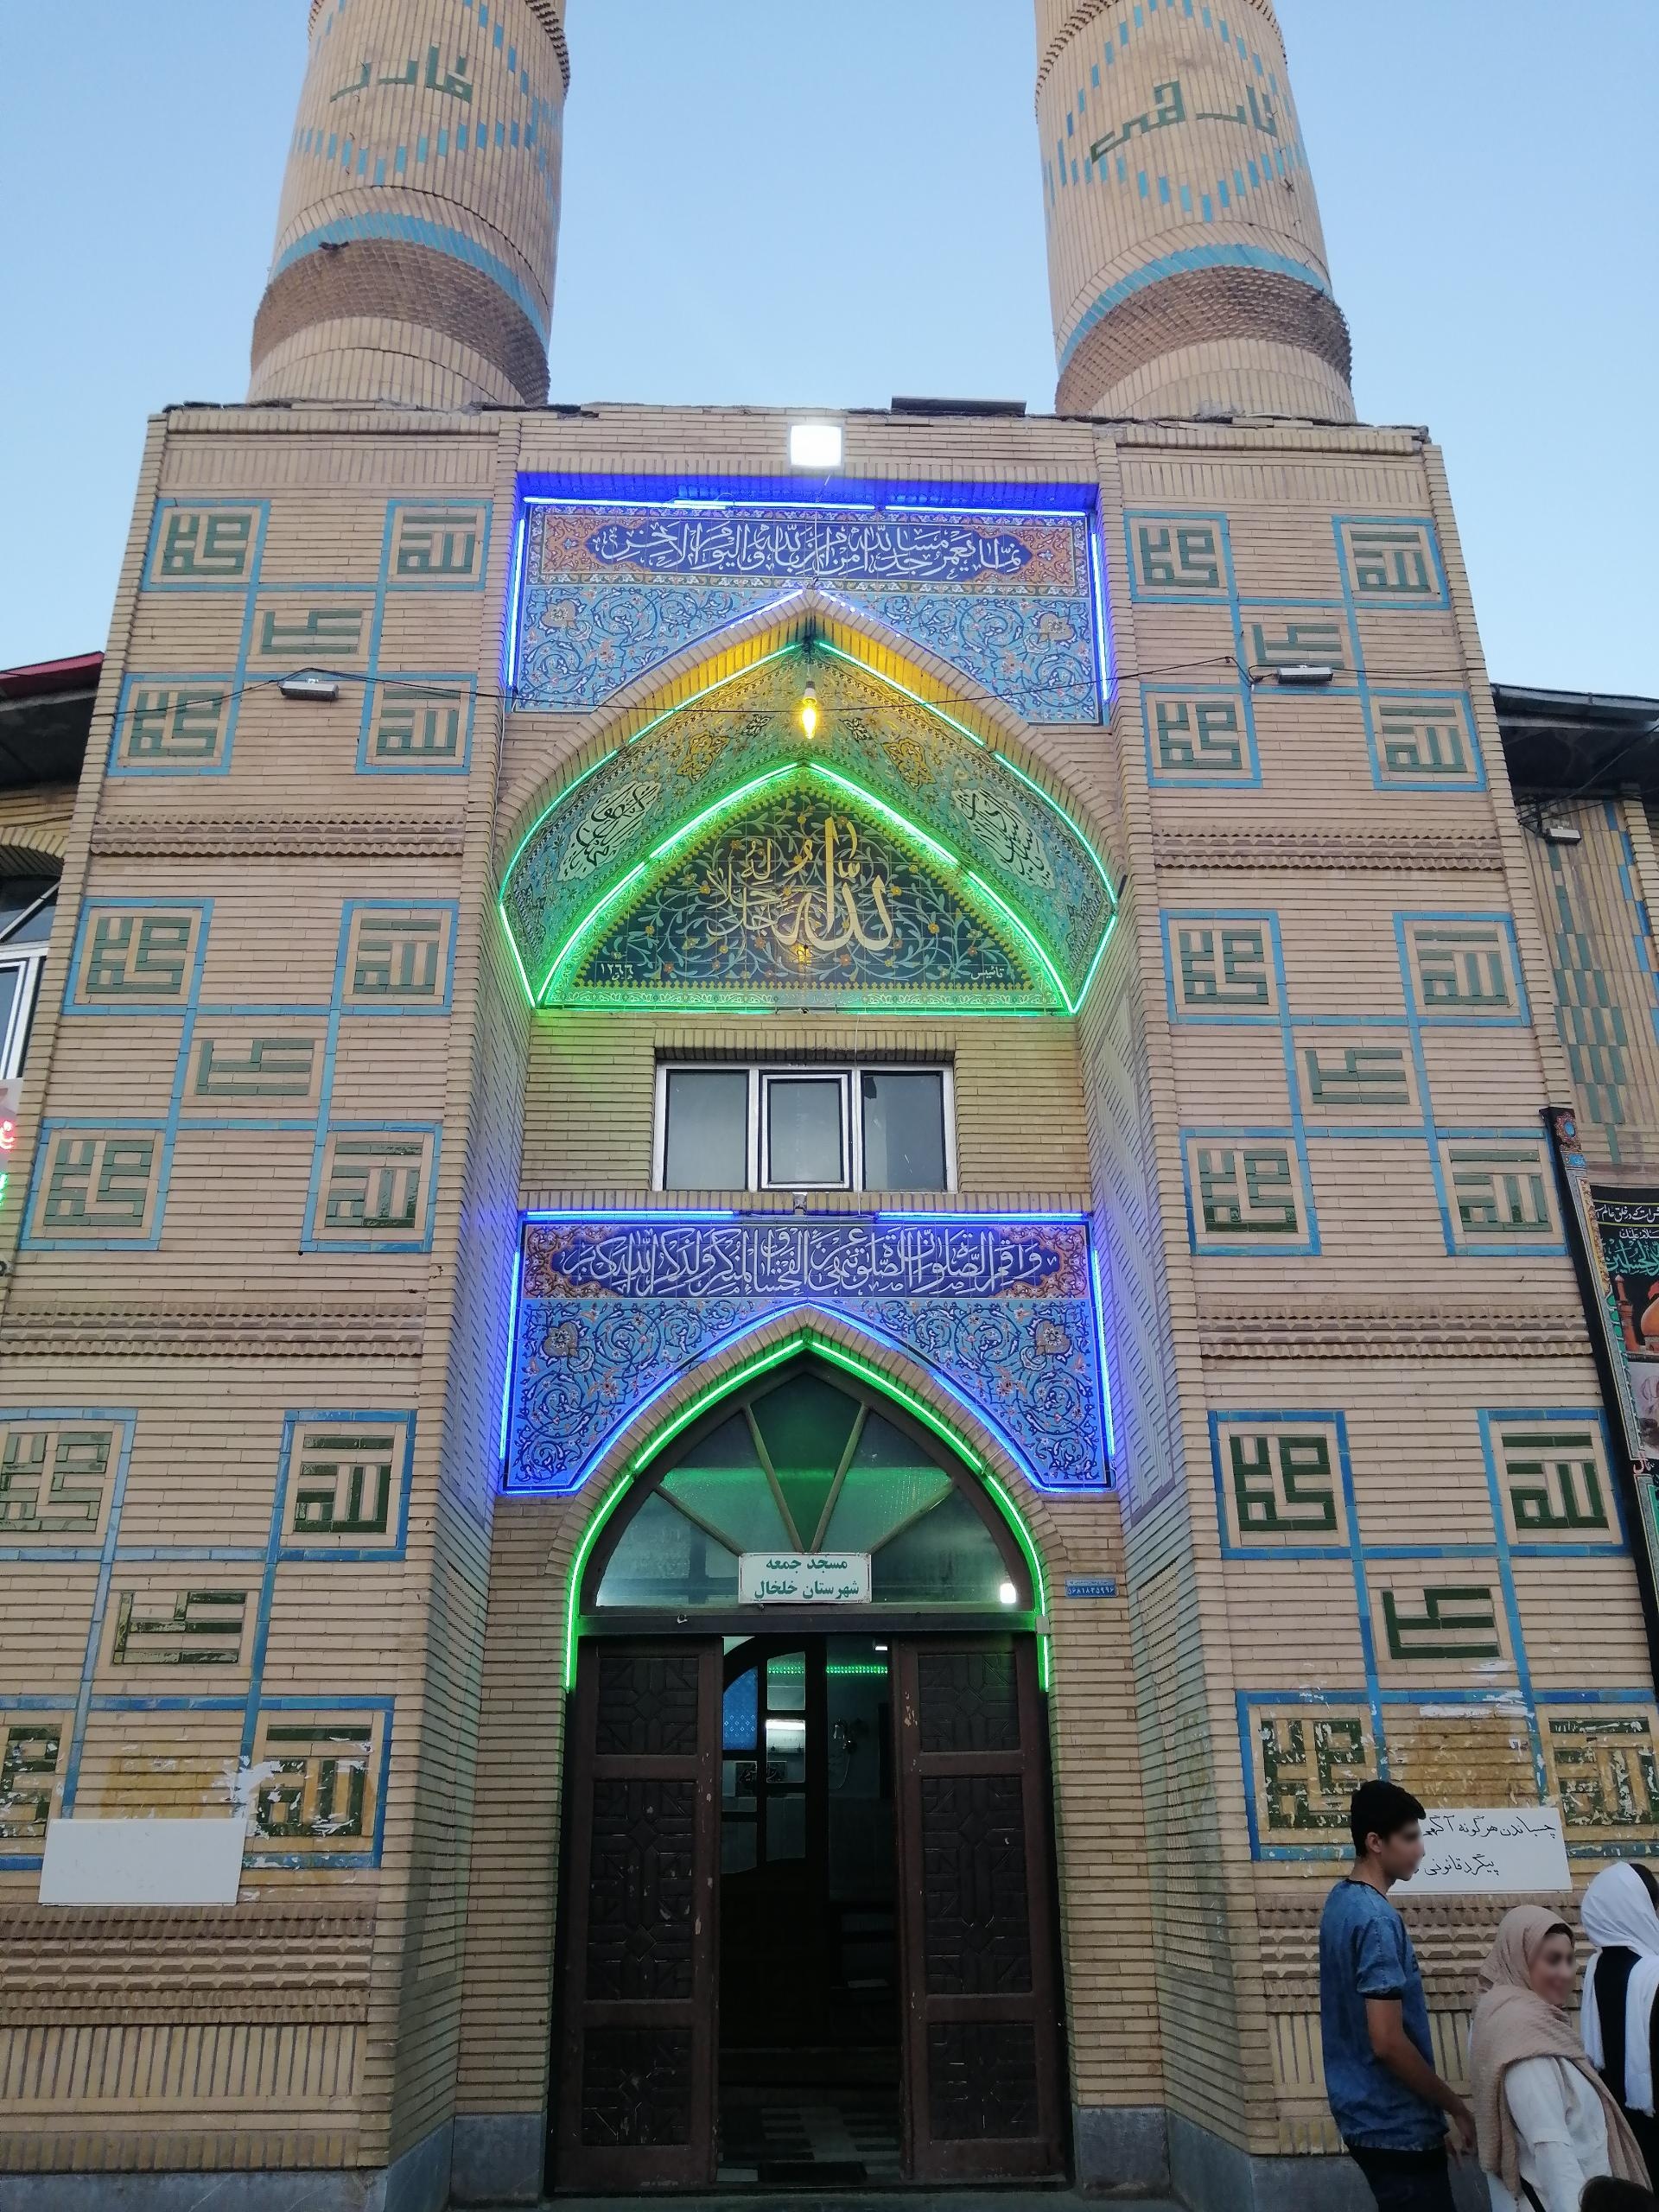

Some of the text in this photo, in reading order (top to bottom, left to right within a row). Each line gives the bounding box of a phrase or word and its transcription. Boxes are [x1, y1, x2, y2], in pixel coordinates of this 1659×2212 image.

[766, 1558, 848, 1573] مسجد جمعه
[754, 1580, 859, 1599] شهرستان خلخال
[1500, 1816, 1556, 1839] چسباندن
[1424, 1853, 1499, 1876] پیگرد قانونی
